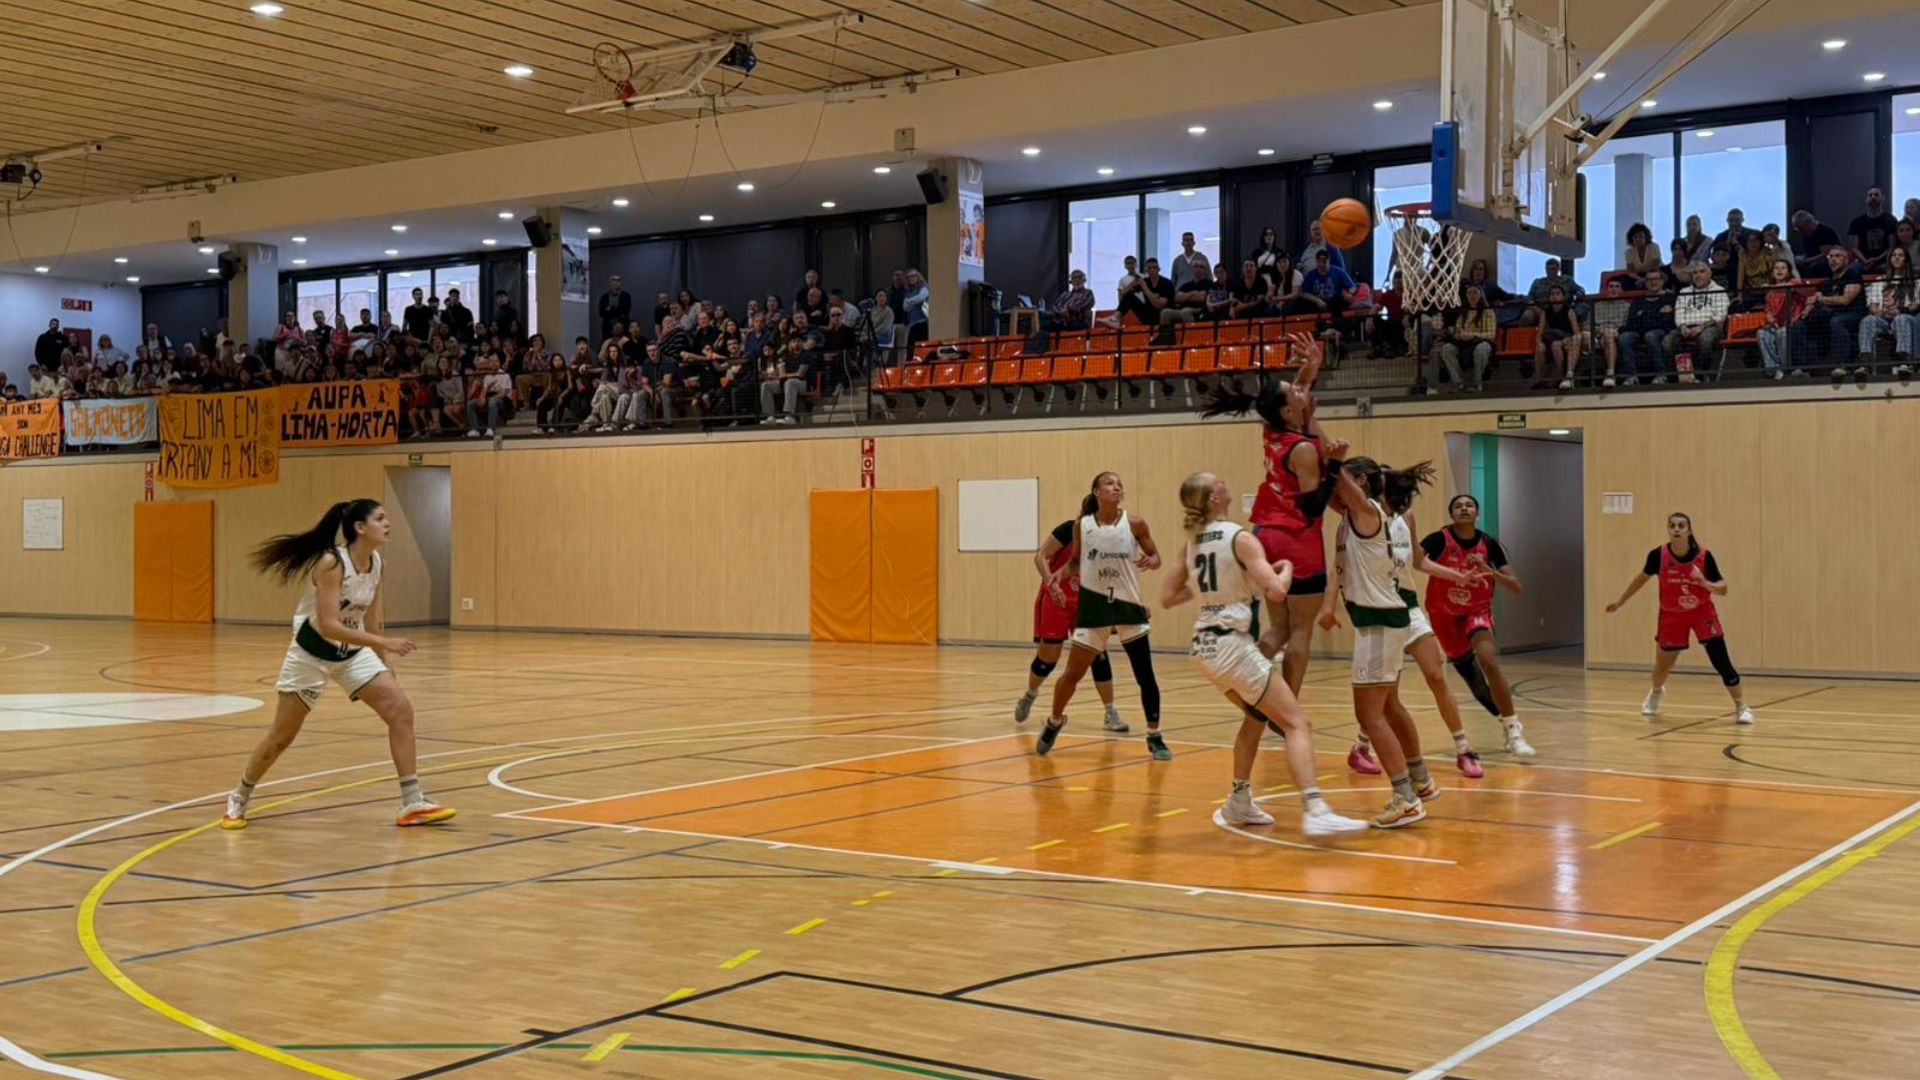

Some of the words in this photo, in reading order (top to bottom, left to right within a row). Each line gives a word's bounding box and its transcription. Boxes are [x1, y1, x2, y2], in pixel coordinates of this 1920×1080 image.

[307, 384, 367, 410] AUPA
[183, 399, 226, 440] LIMA
[234, 396, 258, 439] EM
[281, 409, 398, 441] LIMA-HORTA
[222, 443, 231, 479] A
[240, 440, 258, 478] MI
[1195, 551, 1218, 593] 21
[1106, 586, 1114, 603] 7
